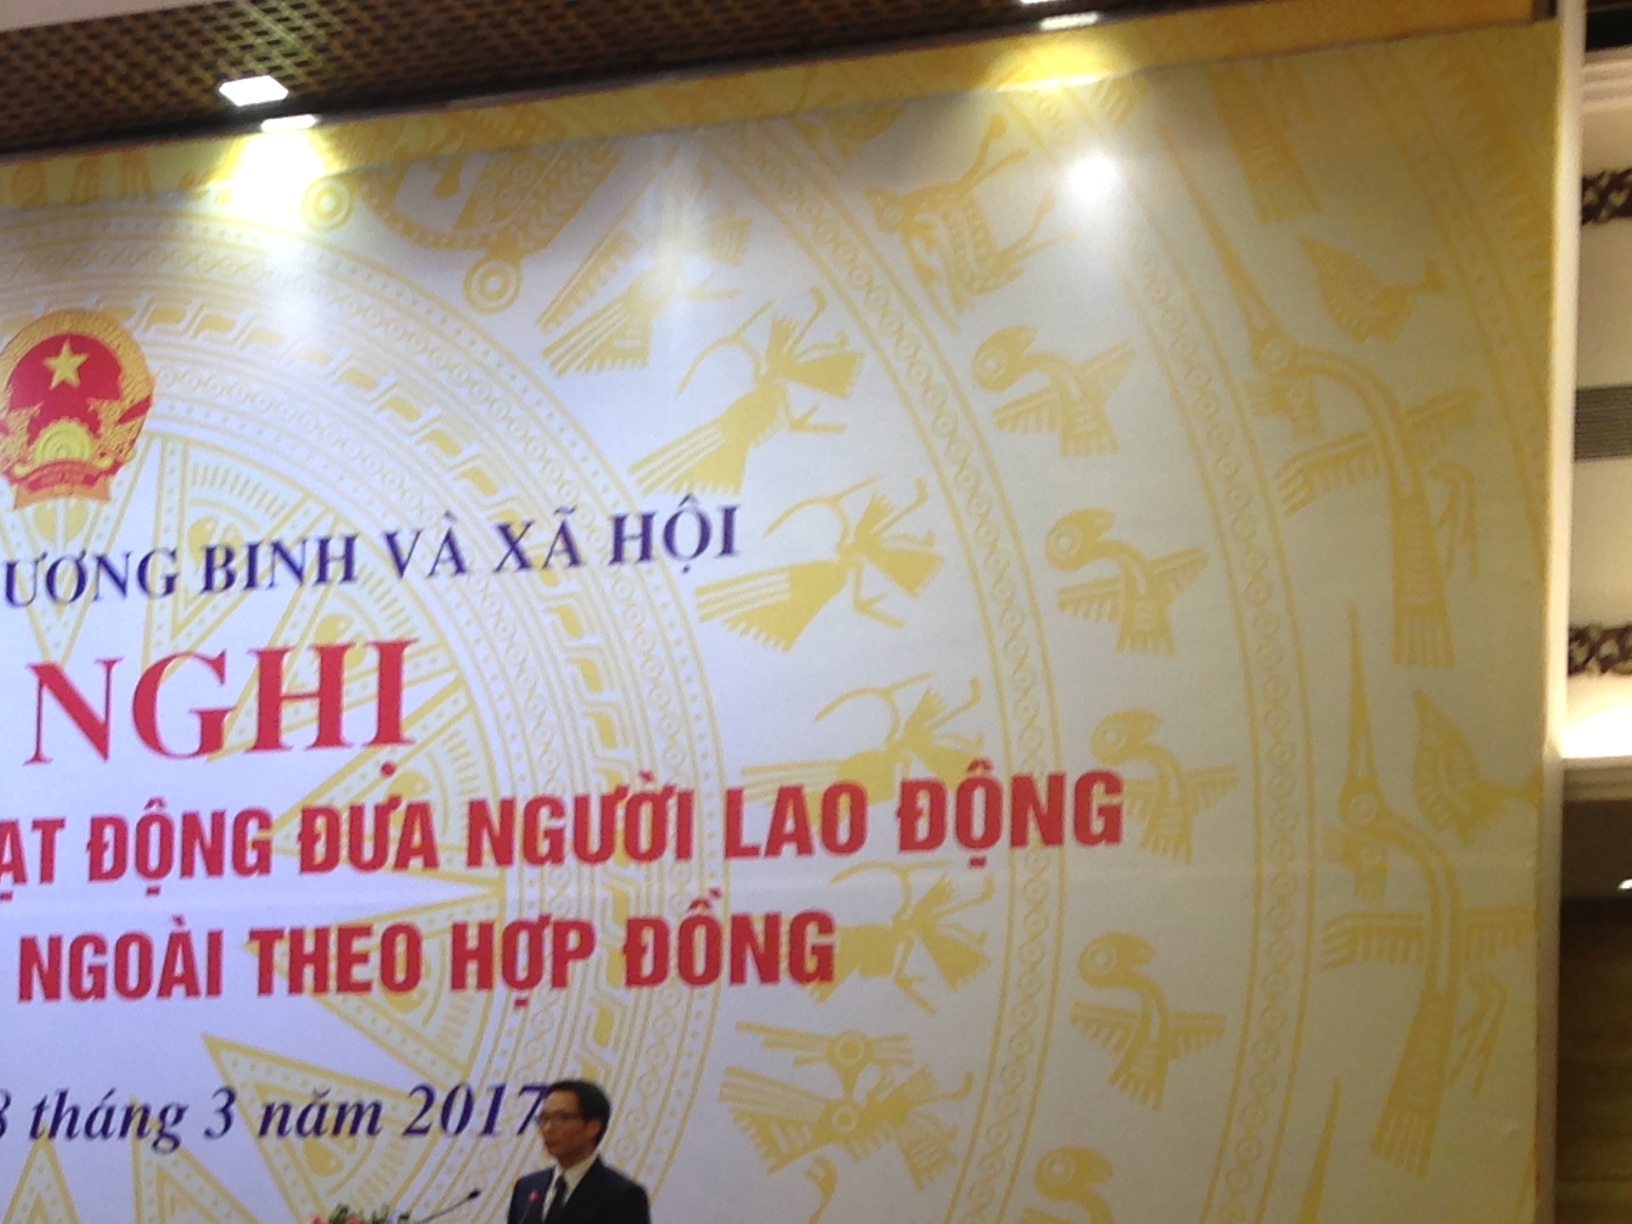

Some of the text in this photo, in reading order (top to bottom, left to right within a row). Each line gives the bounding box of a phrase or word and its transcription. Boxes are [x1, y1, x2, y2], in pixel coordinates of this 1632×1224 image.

[200, 535, 357, 594] BINH
[383, 510, 468, 579] VÀ
[494, 506, 583, 573] XÃ
[606, 493, 739, 574] HỘI
[24, 636, 417, 777] NGHỊ
[87, 799, 274, 896] ĐỘNG
[297, 794, 440, 874] ĐƯA
[465, 771, 695, 869] NGƯỜI
[723, 780, 869, 860] LAO
[895, 758, 1124, 868] ĐỘNG
[18, 917, 224, 1002] NGOÀI
[249, 922, 424, 996] THEO
[450, 913, 597, 1009] HỢP
[620, 888, 836, 989] ĐỒNG
[27, 1086, 190, 1156] tháng
[202, 1085, 238, 1141] 3
[258, 1086, 385, 1140] năm
[401, 1080, 548, 1139] 2017
